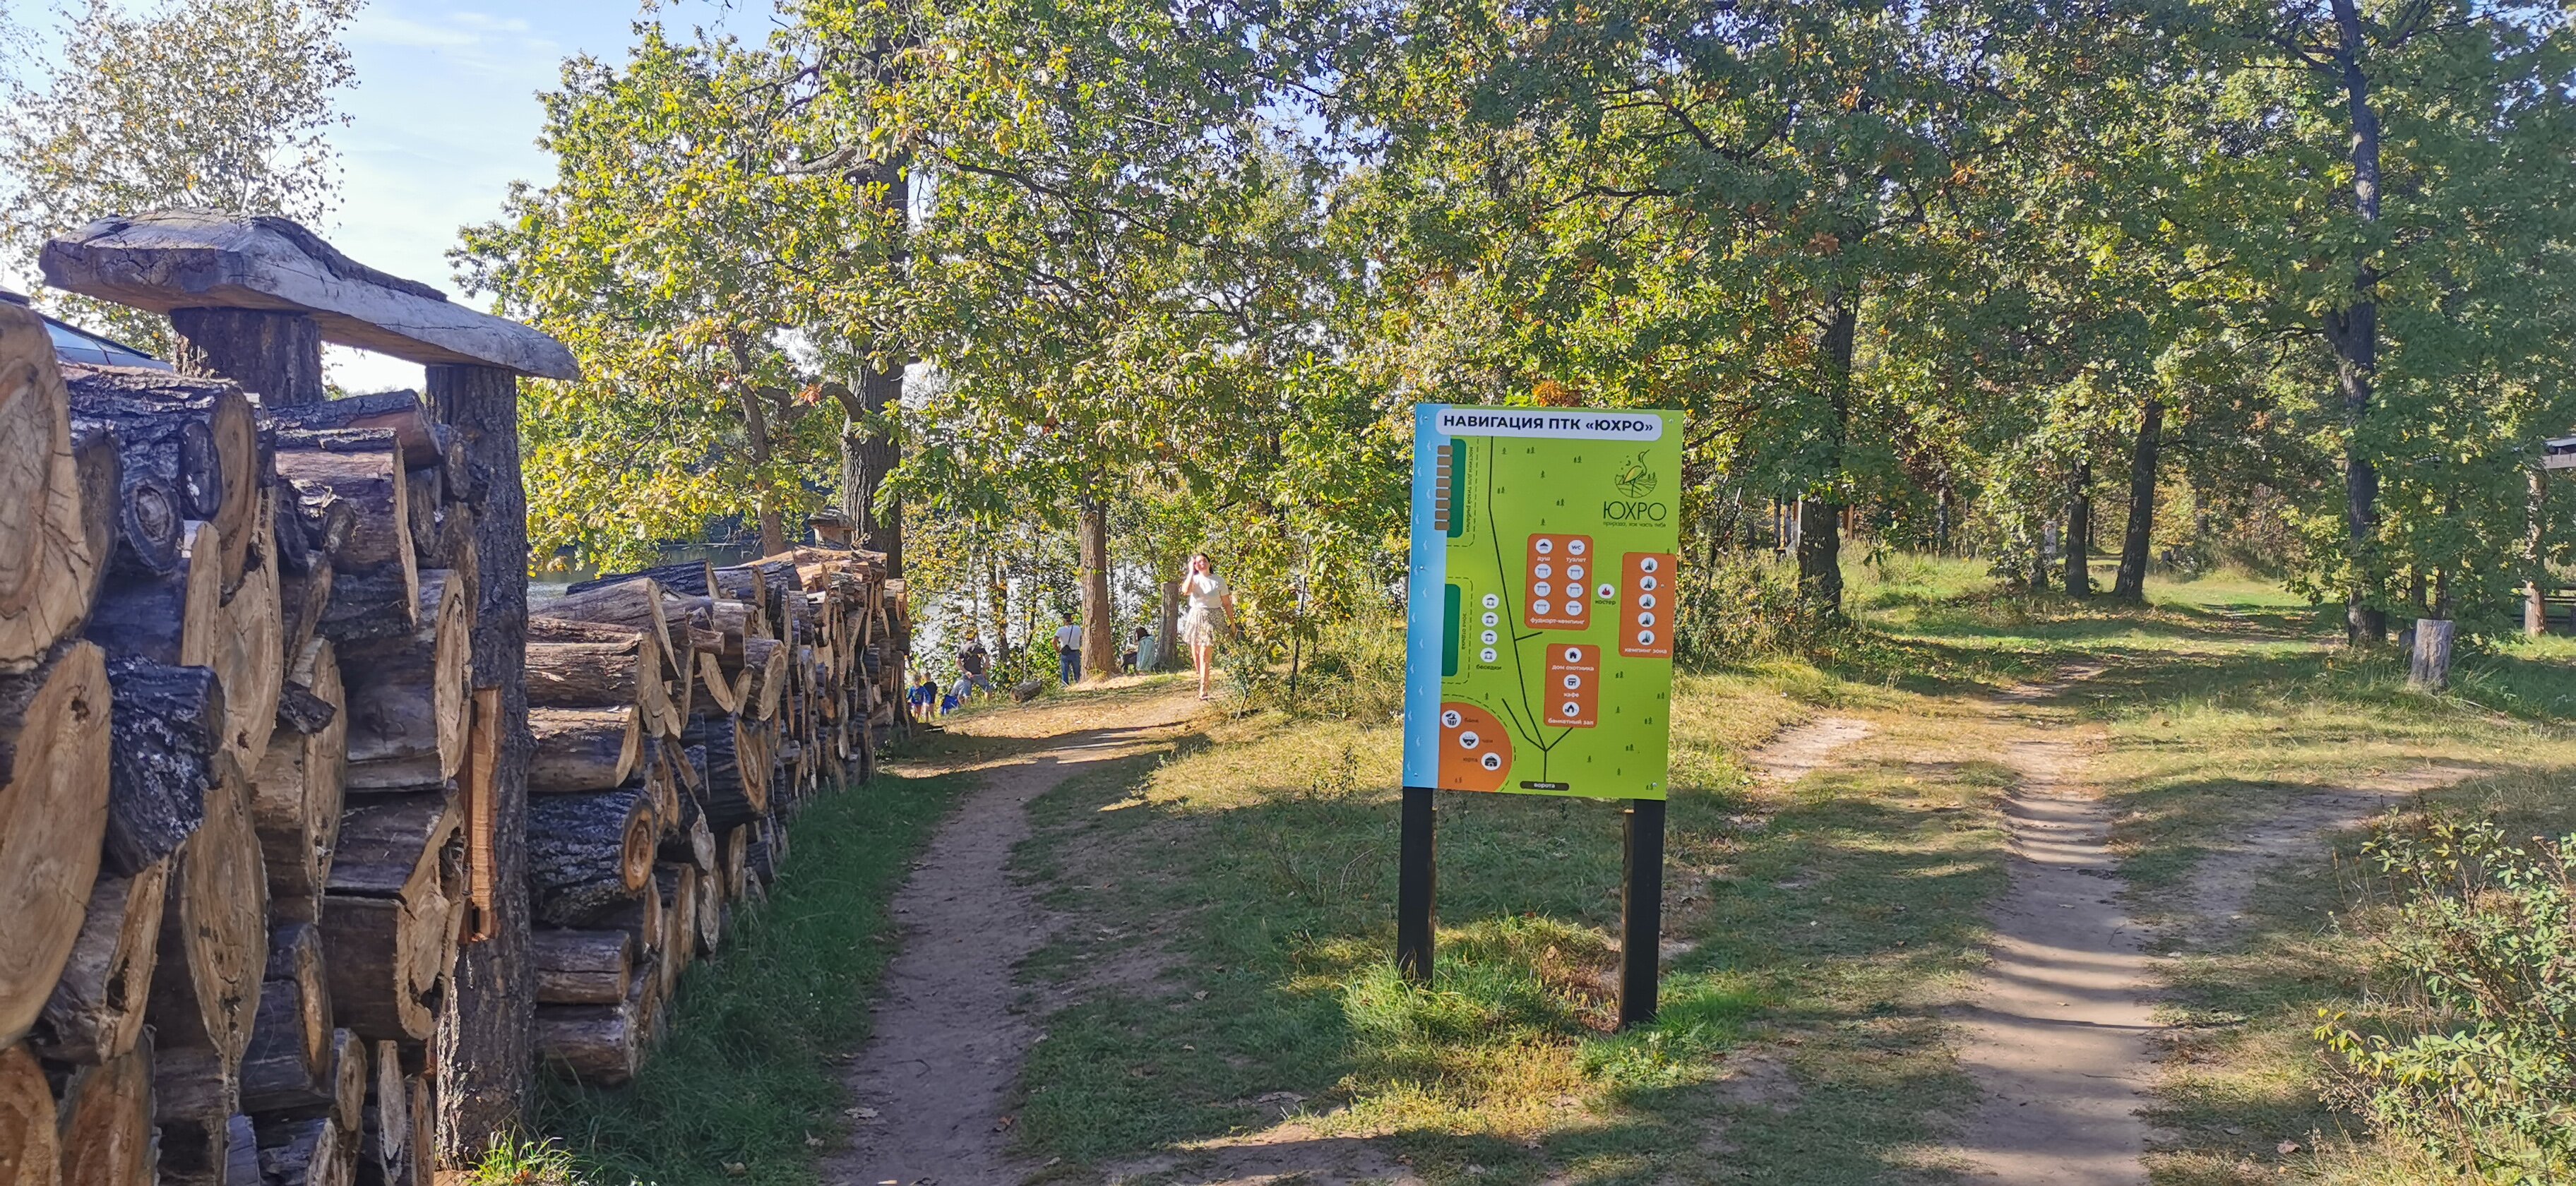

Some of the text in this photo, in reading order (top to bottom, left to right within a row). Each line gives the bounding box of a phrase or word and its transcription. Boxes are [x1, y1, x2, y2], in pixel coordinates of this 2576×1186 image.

[1444, 415, 1653, 431] НАВИГАЦИЯ ПТК «ЮХРО»
[1603, 501, 1666, 521] ЮХРО
